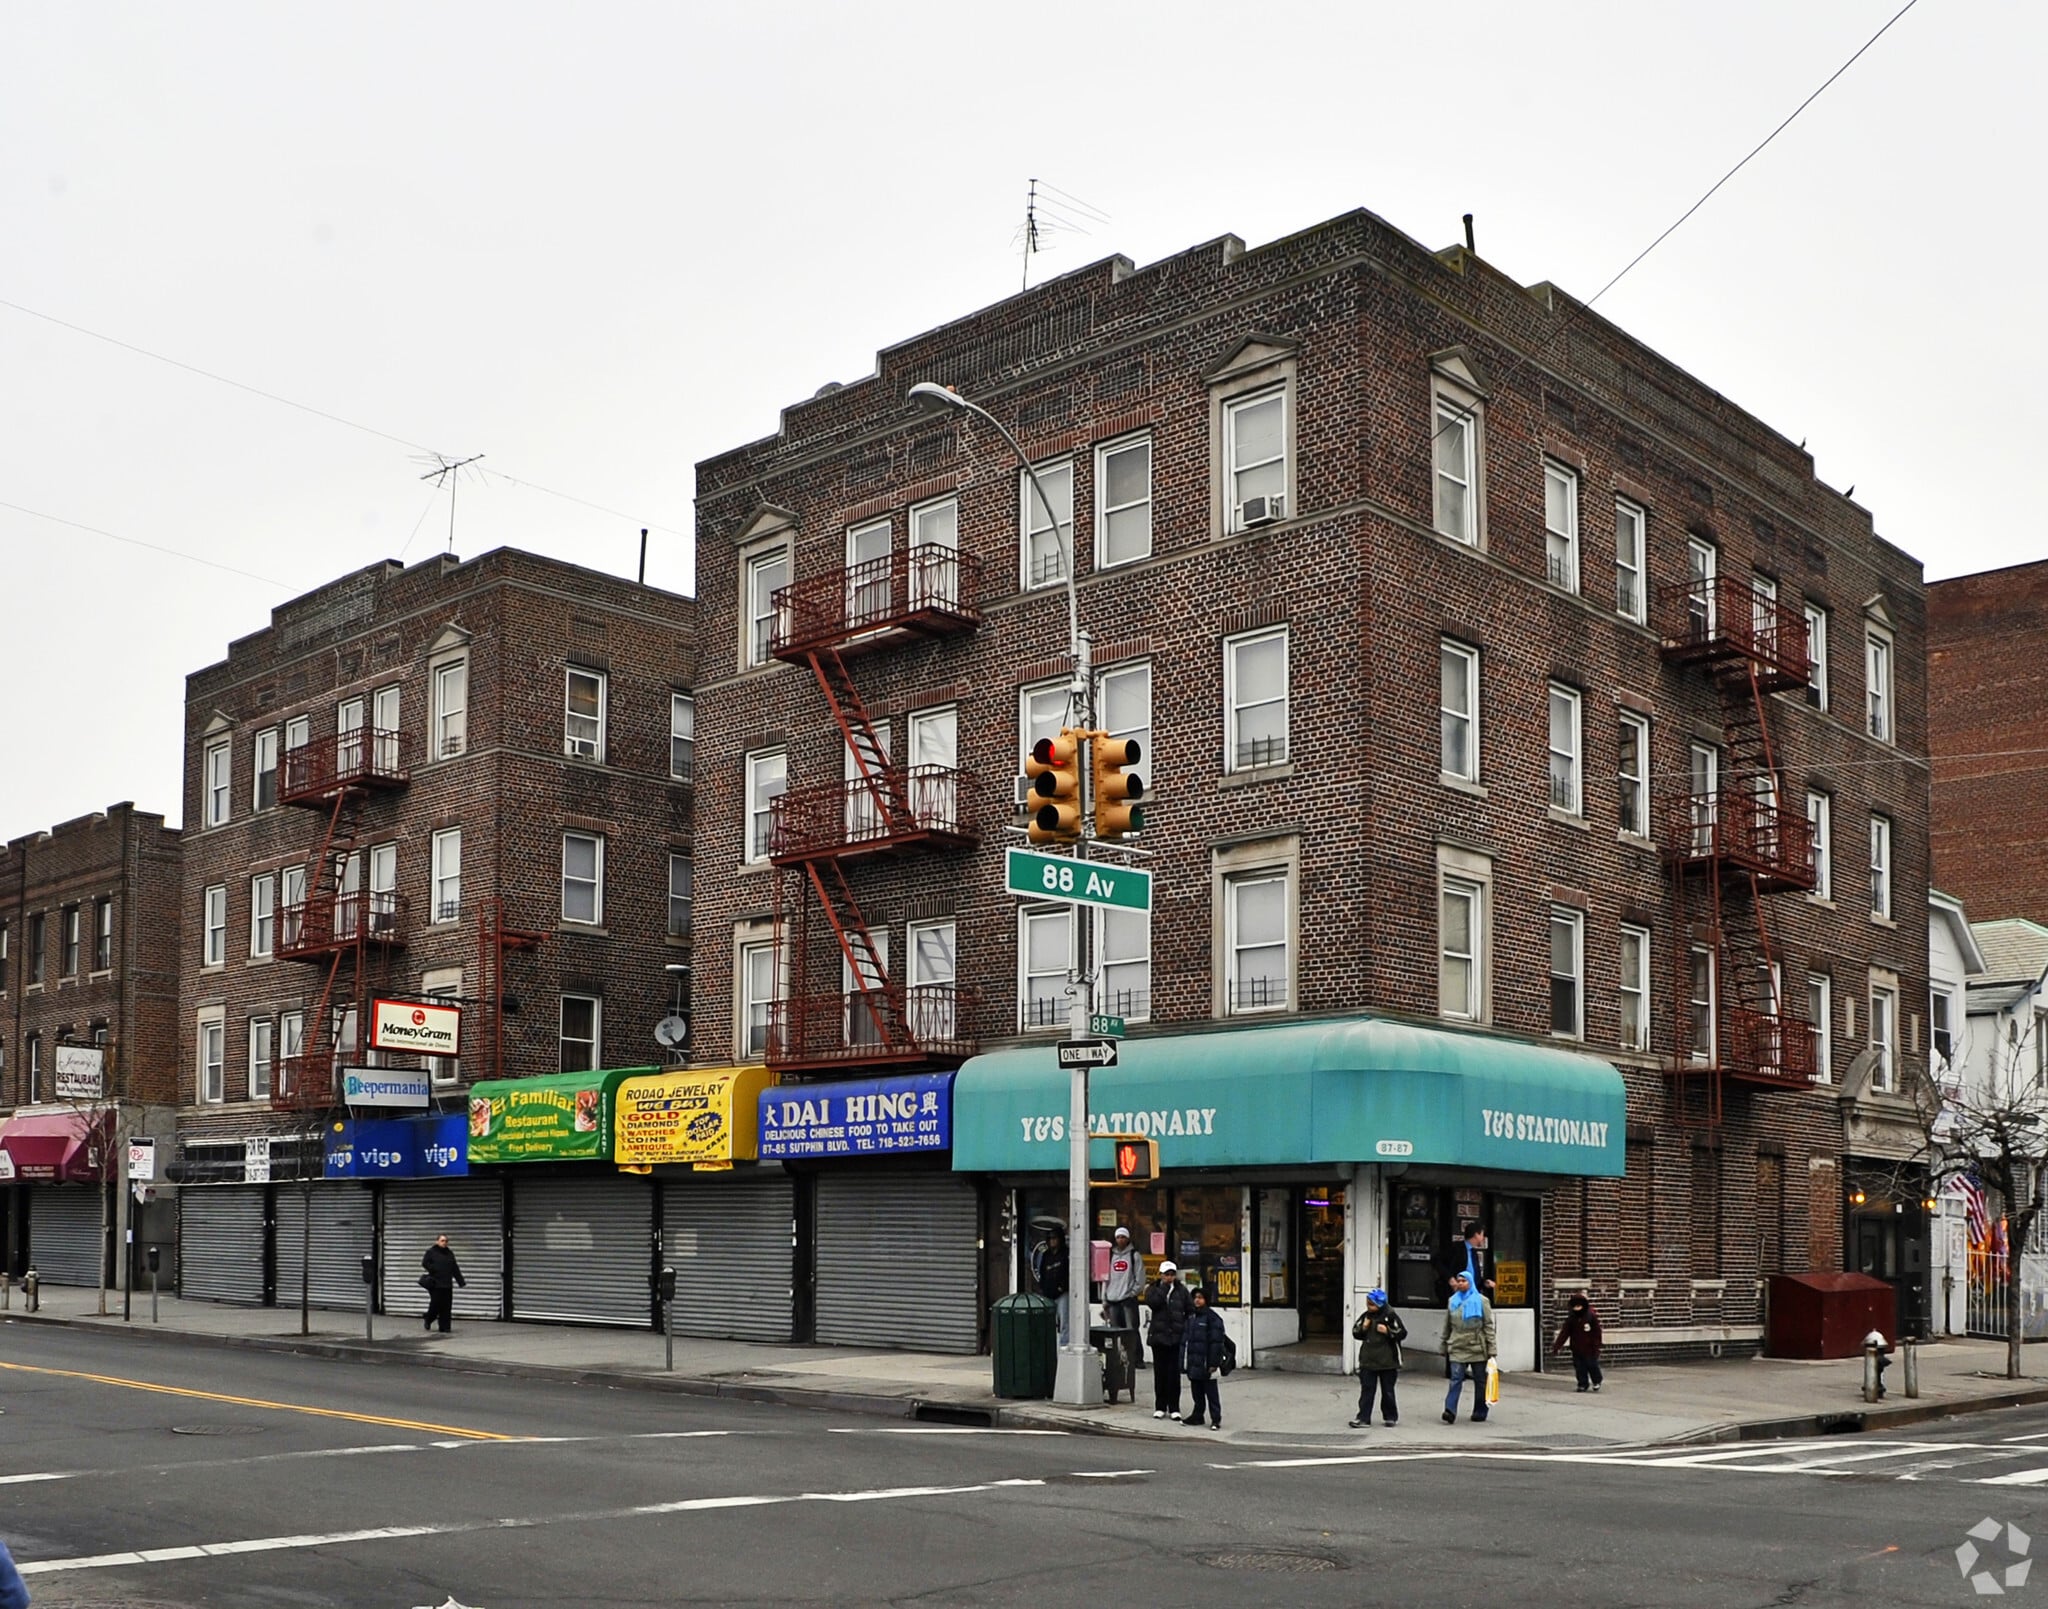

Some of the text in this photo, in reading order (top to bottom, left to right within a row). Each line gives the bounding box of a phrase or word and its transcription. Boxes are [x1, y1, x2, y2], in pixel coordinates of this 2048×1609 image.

[1042, 864, 1115, 898] 88 Av
[382, 1023, 452, 1040] MoneyGram
[1092, 1017, 1109, 1033] 88
[1063, 1047, 1109, 1060] ONE WAY
[57, 1072, 101, 1086] RESTAURANT
[347, 1076, 429, 1099] Beepermania
[669, 1083, 725, 1098] JEWELRY
[510, 1090, 575, 1112] Familiar
[782, 1092, 918, 1127] DAI HING
[505, 1113, 558, 1128] Restaurant
[627, 1120, 680, 1129] DIAMONDS
[628, 1112, 680, 1121] GOLD
[1021, 1108, 1217, 1142] Y&S TATIONARY
[627, 1129, 676, 1137] WATCHES
[765, 1120, 938, 1140] DELICIOUS CHINESE FOOD TO TAKE OUT
[1482, 1109, 1609, 1148] Y&S STATIONARY
[789, 1141, 824, 1153] SUTPHIN
[827, 1140, 850, 1152] BLVD.
[856, 1138, 875, 1150] TEL:
[327, 1150, 352, 1168] vigo
[361, 1148, 402, 1168] vigo
[424, 1143, 458, 1168] vigo
[1217, 1270, 1240, 1295] 083
